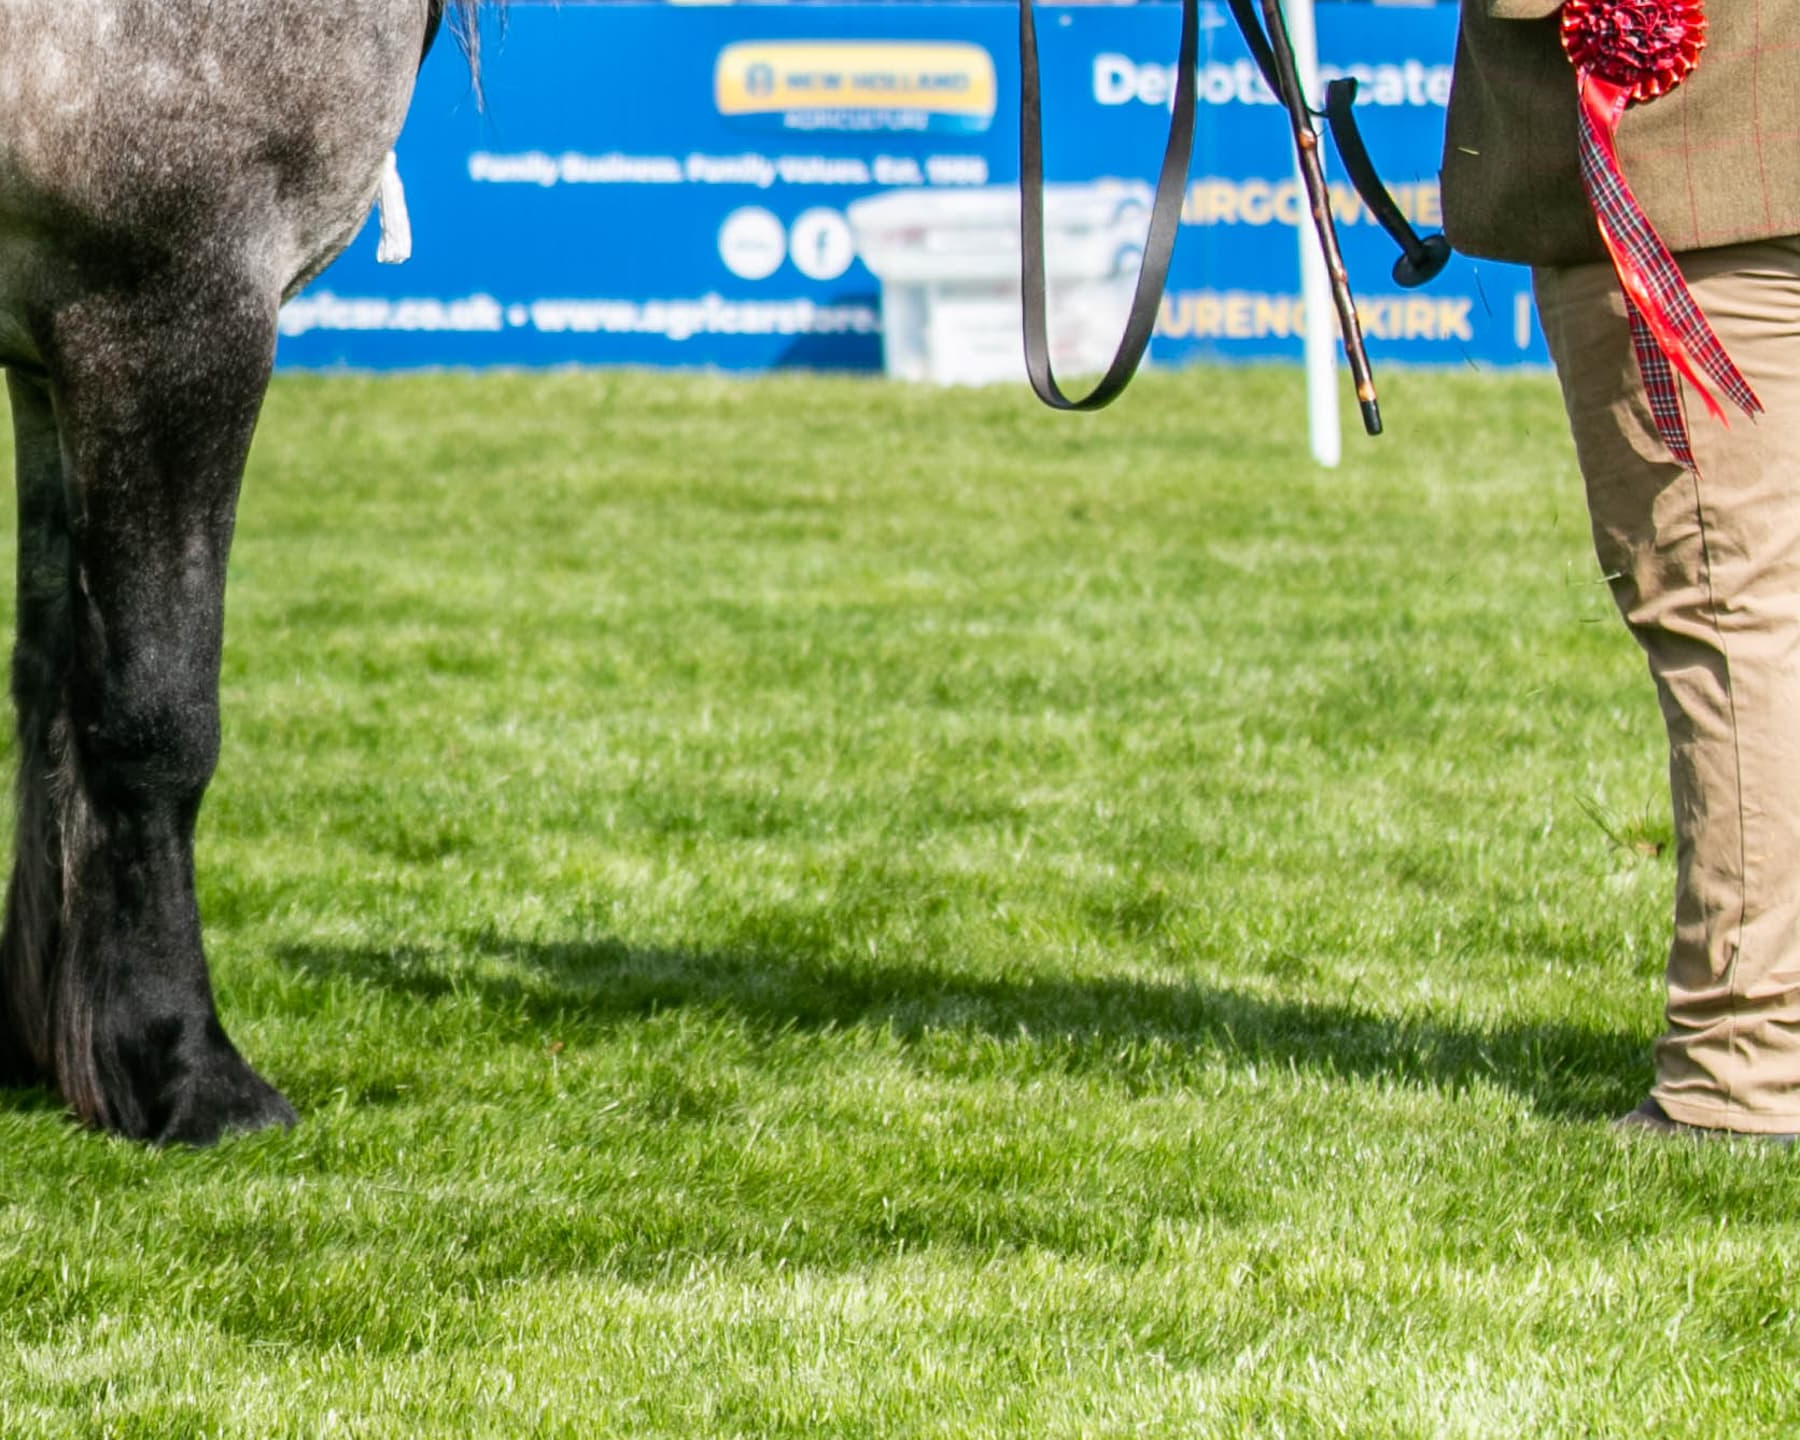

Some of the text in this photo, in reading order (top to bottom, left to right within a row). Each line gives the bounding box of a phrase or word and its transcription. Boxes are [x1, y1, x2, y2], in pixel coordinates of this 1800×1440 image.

[786, 71, 970, 92] NEW HOLLAND
[783, 110, 929, 131] AGRICULTURE
[468, 150, 559, 188] Family
[687, 151, 776, 188] Family
